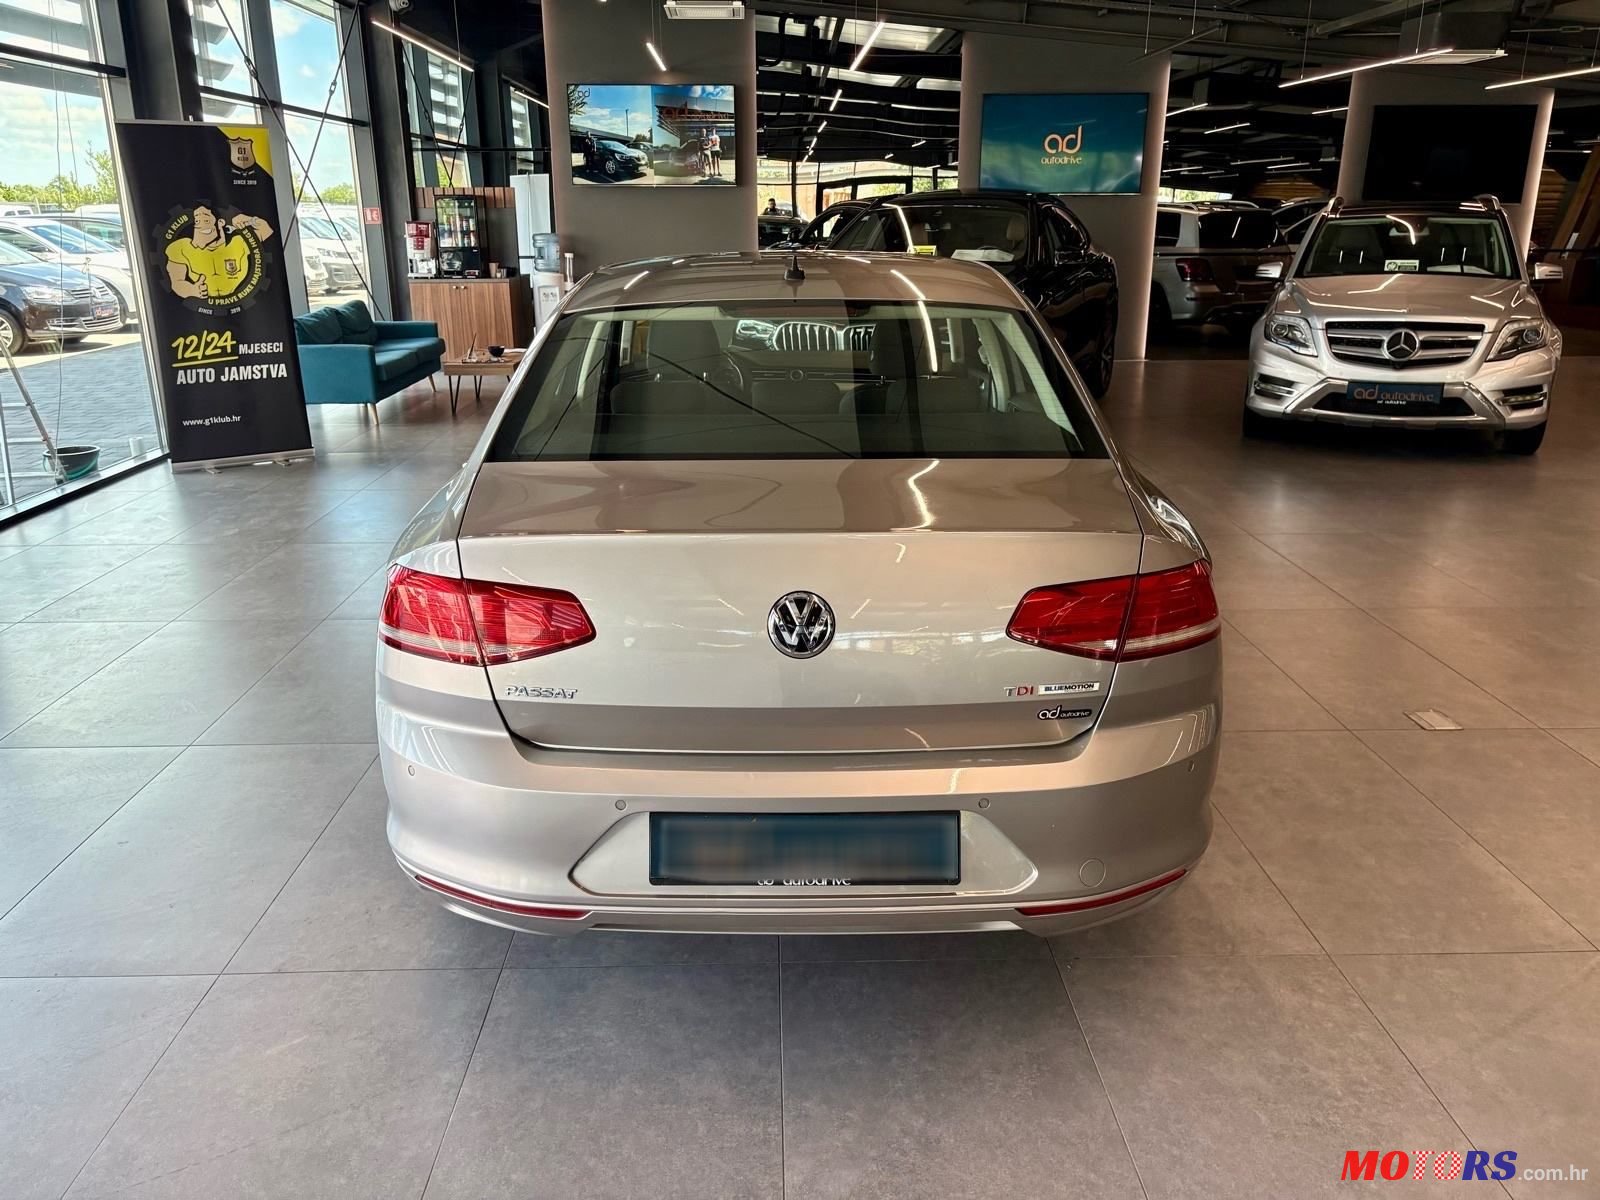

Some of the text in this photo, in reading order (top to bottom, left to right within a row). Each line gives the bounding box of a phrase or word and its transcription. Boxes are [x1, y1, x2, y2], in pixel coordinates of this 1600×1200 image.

[1044, 125, 1082, 153] ad
[1041, 156, 1082, 164] autodrive
[173, 214, 189, 231] KLUB
[215, 296, 237, 306] PRAVE
[238, 285, 255, 300] RUKE
[250, 249, 262, 285] MAJSTORA
[171, 329, 283, 360] 12/24 MJESECI
[176, 363, 288, 385] AUTO JAMSTVA
[182, 415, 241, 427] www.g1klub.hr
[505, 685, 578, 699] PASSAT
[1003, 686, 1034, 697] TDI
[1039, 706, 1060, 719] ad
